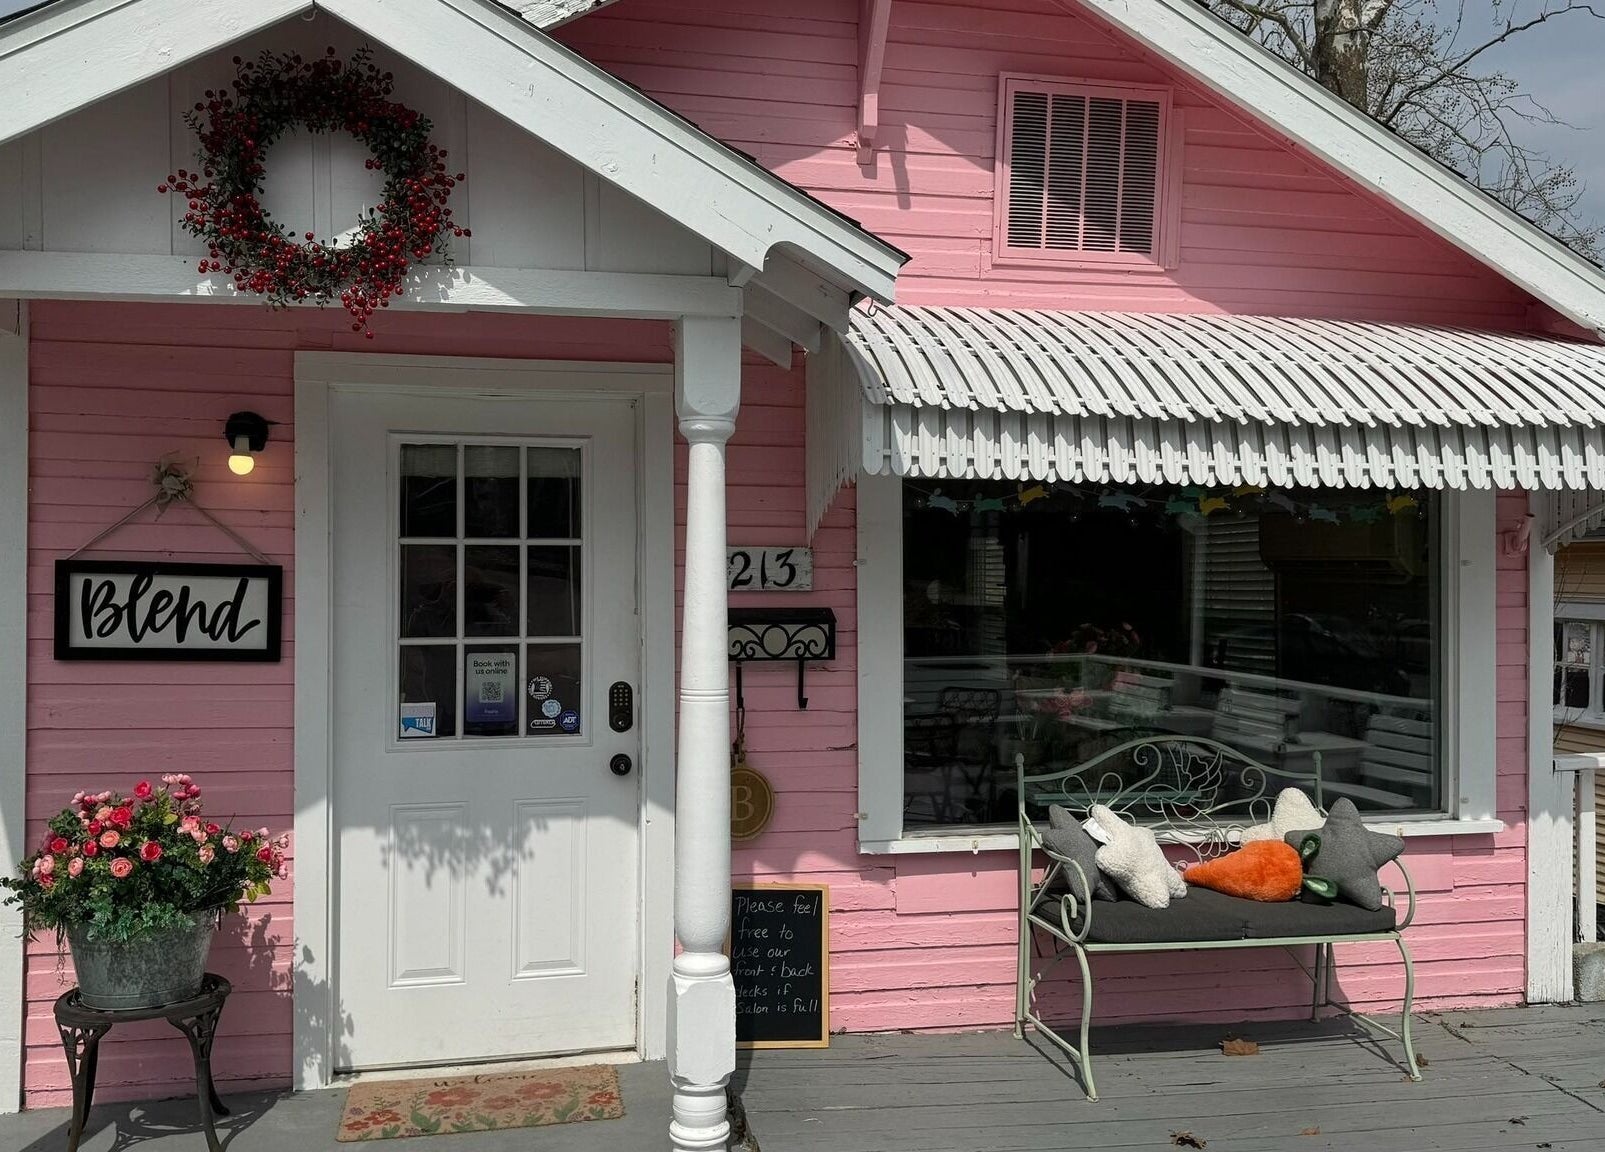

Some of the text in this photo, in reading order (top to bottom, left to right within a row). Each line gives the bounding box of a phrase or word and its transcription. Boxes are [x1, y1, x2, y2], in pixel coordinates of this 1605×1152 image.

[80, 574, 261, 643] Blend
[473, 660, 510, 668] Book with
[563, 716, 577, 725] ADT
[735, 895, 819, 916] Please feel
[738, 917, 794, 940] free to
[767, 946, 791, 957] our
[734, 961, 765, 976] front
[781, 961, 815, 978] back
[777, 982, 793, 998] if
[777, 1003, 787, 1012] is
